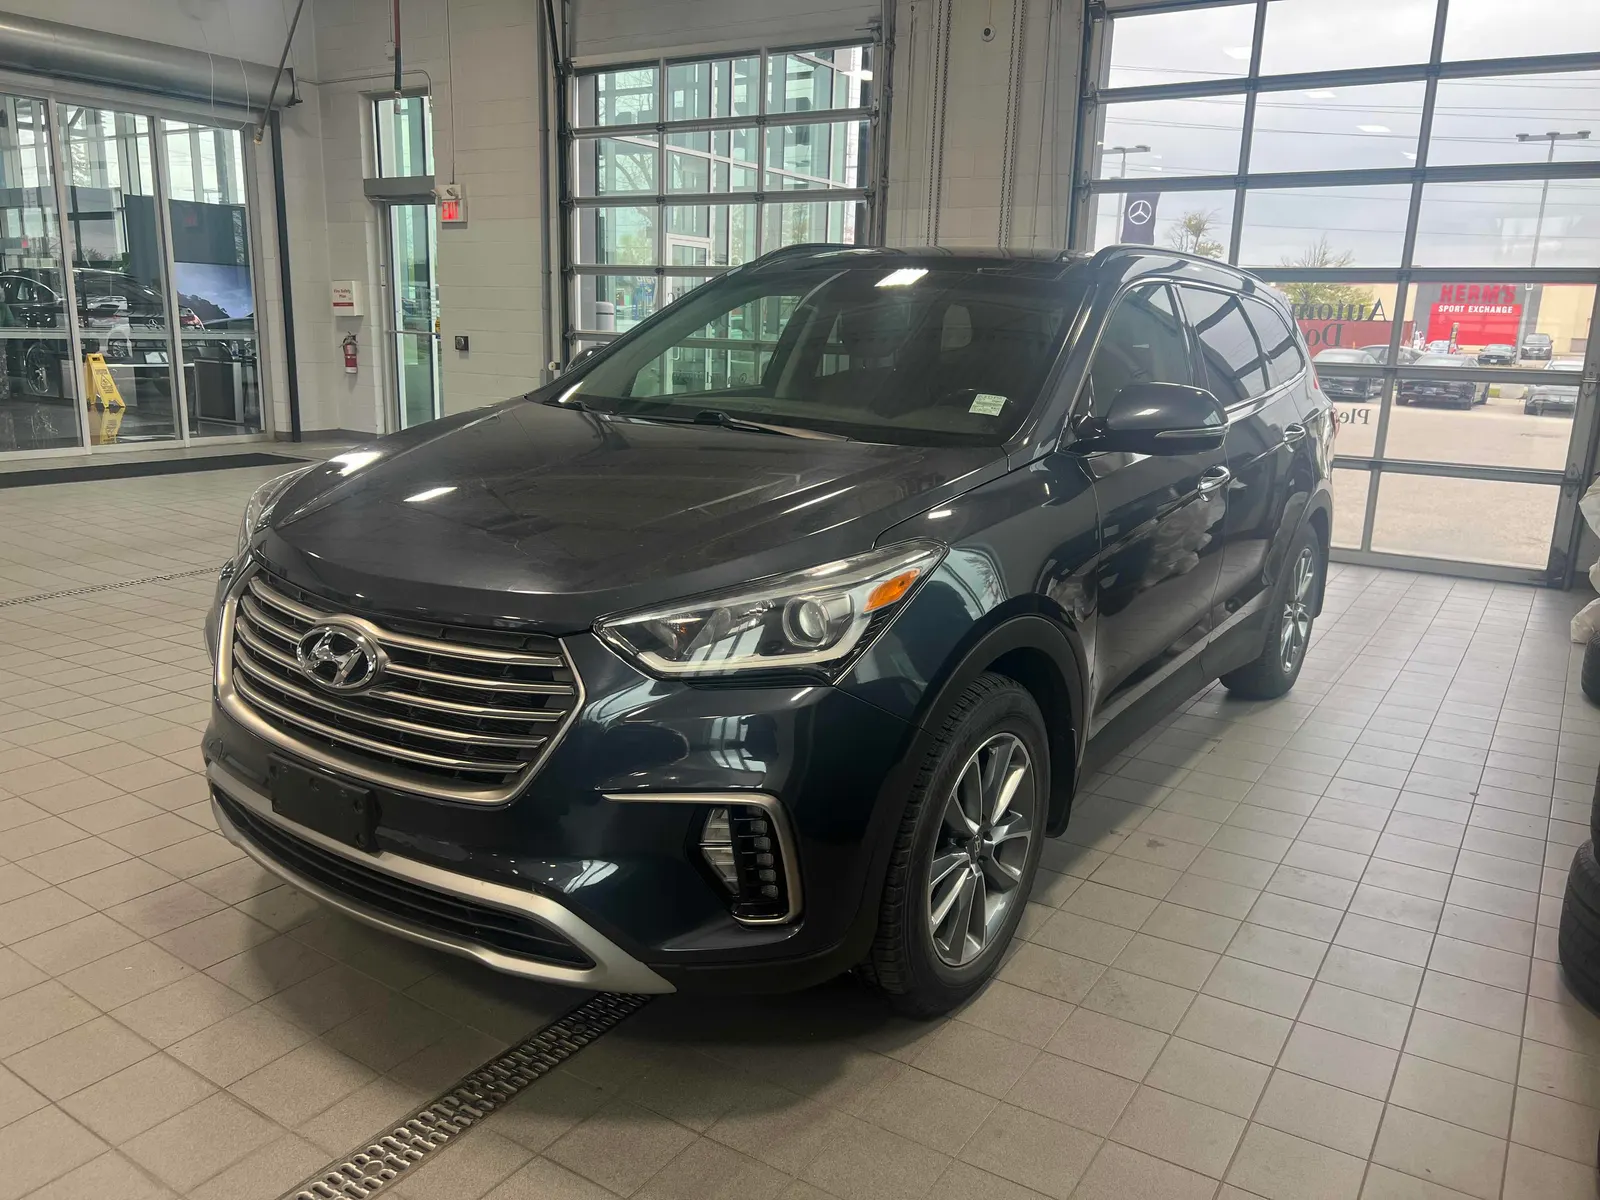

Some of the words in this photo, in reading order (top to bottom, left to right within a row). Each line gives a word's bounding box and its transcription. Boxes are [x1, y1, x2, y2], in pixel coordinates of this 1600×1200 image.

[441, 201, 458, 220] EXIT
[1440, 283, 1516, 303] HERM'S
[1438, 305, 1465, 313] SPORT
[1468, 305, 1513, 314] EXCHANGE
